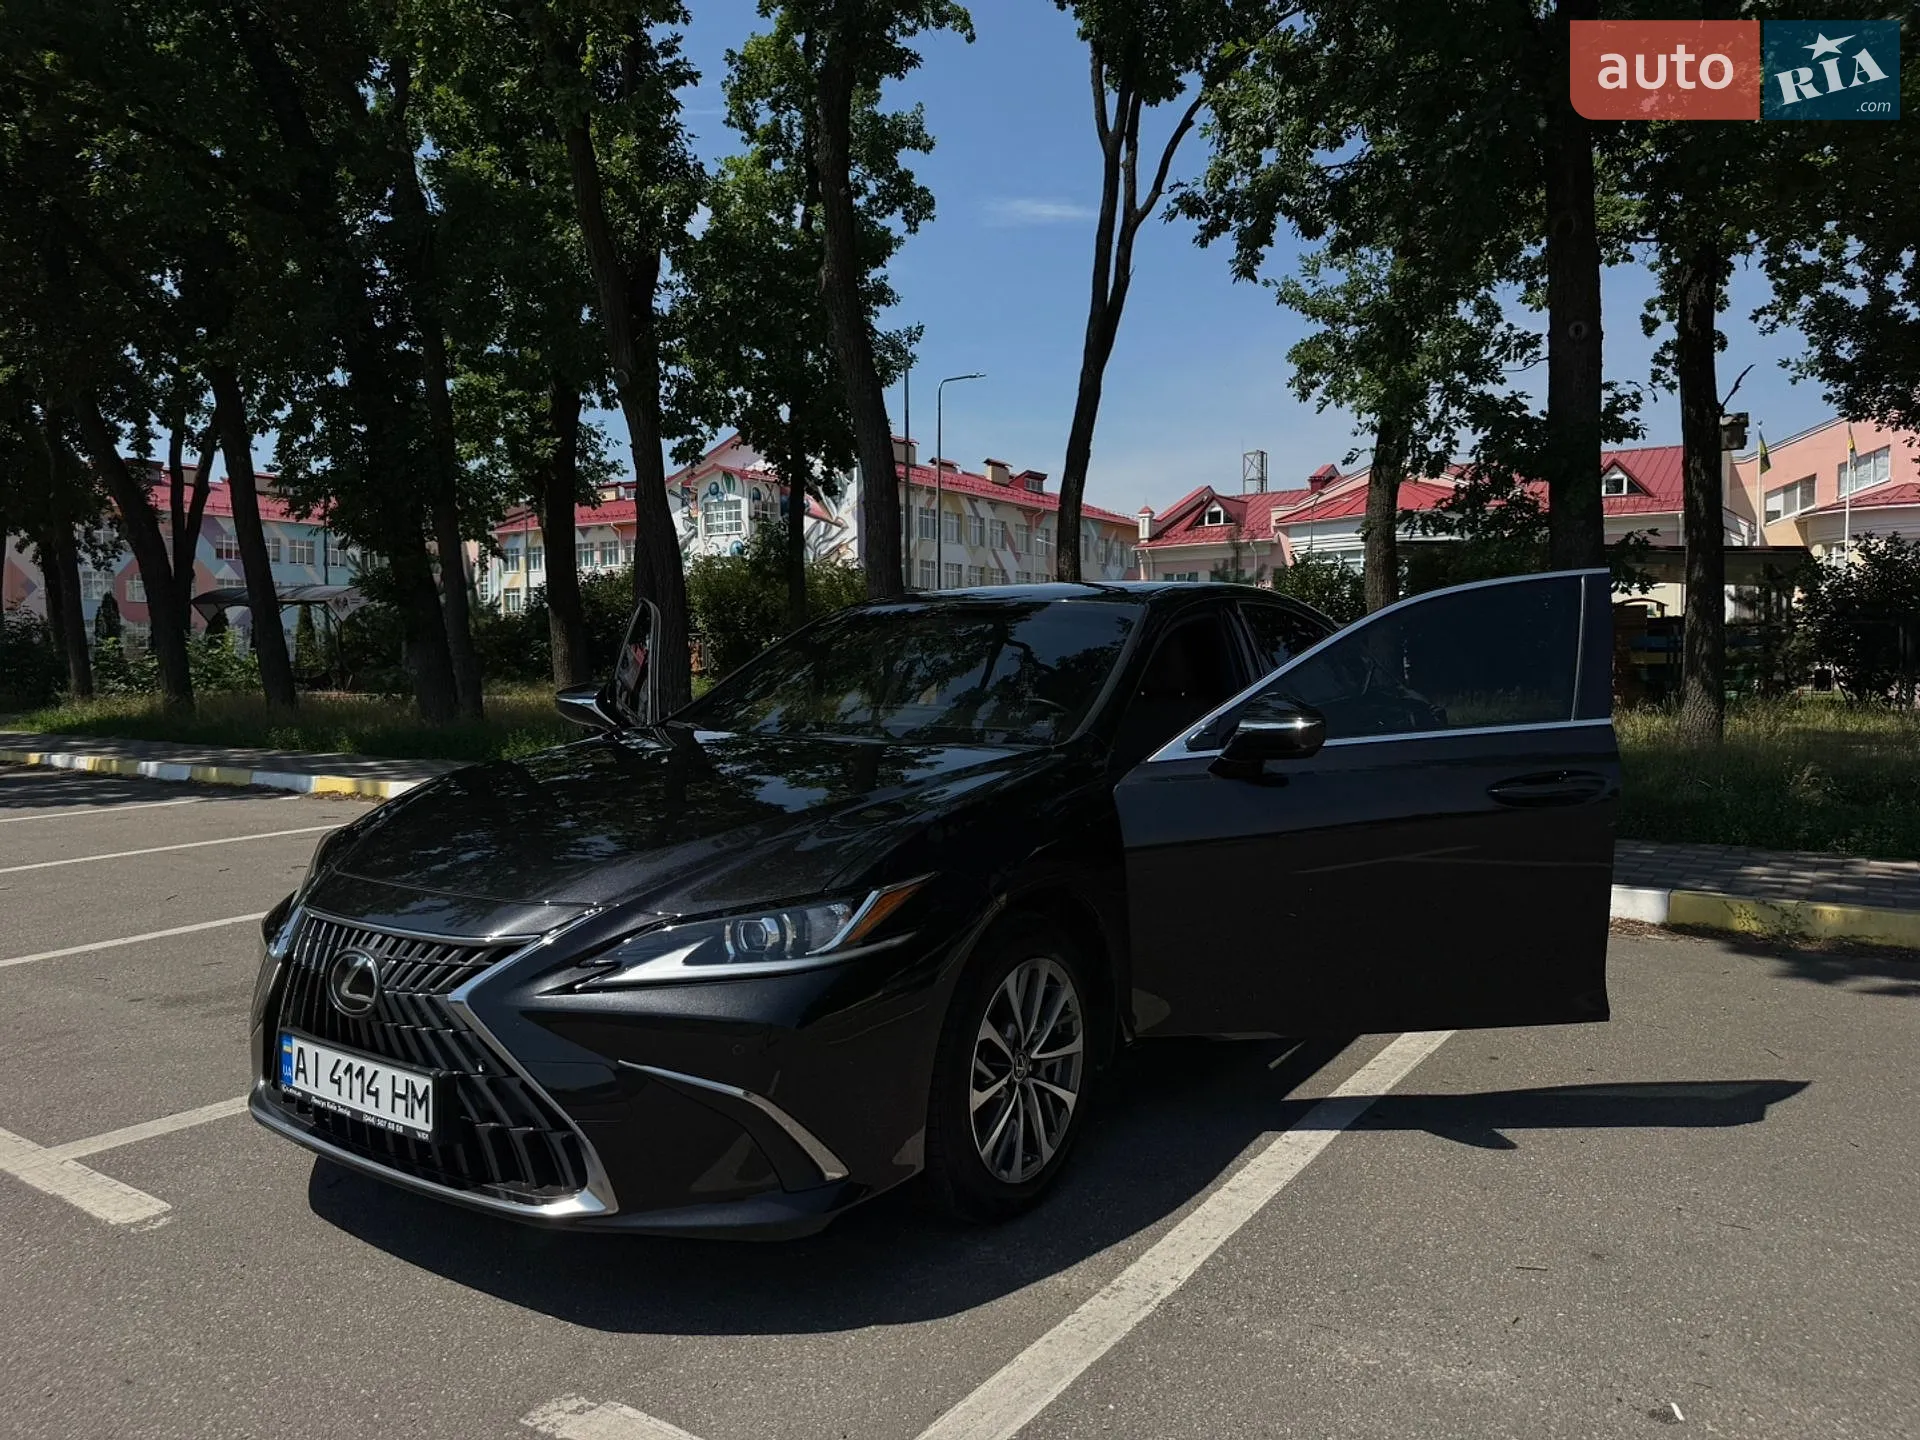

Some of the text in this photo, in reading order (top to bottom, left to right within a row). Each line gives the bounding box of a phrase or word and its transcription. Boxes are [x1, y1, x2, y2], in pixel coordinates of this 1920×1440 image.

[282, 1063, 292, 1077] UA
[295, 1046, 430, 1125] AI 4114 HM
